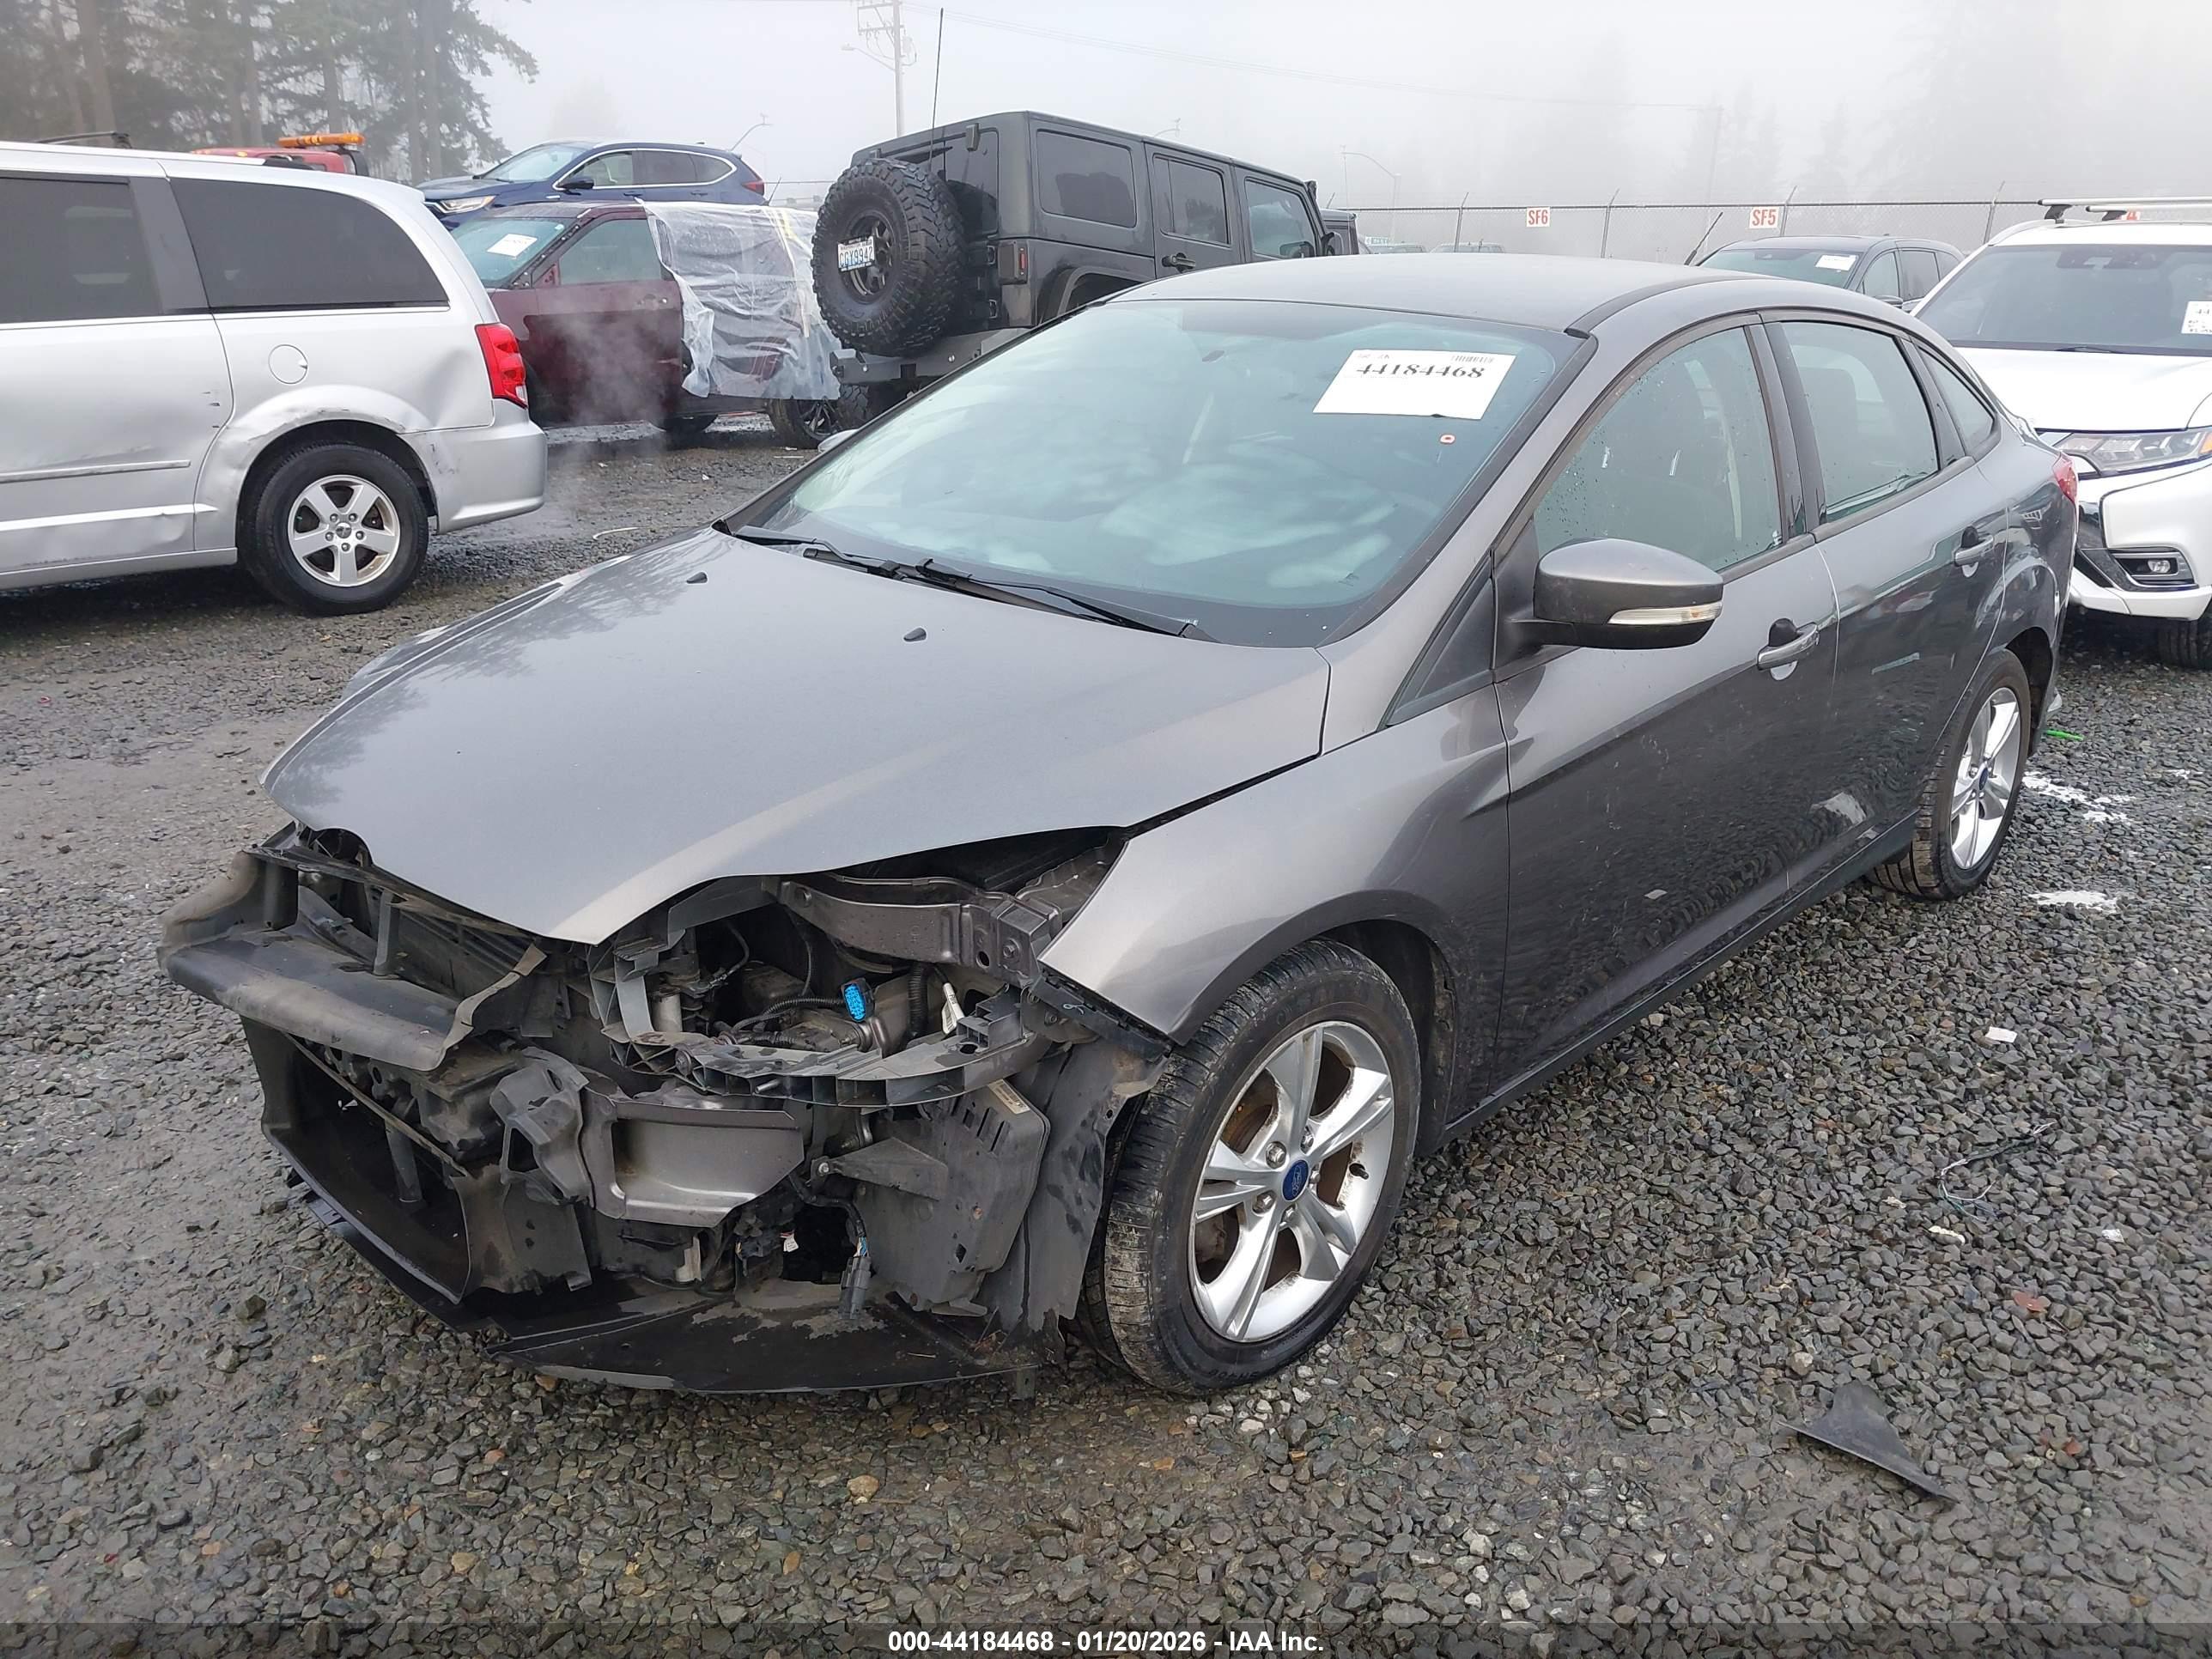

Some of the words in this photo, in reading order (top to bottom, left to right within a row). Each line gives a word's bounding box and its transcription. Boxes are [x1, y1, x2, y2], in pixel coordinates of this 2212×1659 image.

[1528, 210, 1548, 225] SF6
[1752, 209, 1777, 226] SF5
[840, 246, 873, 268] CGY9942
[1356, 363, 1485, 378] 44184468
